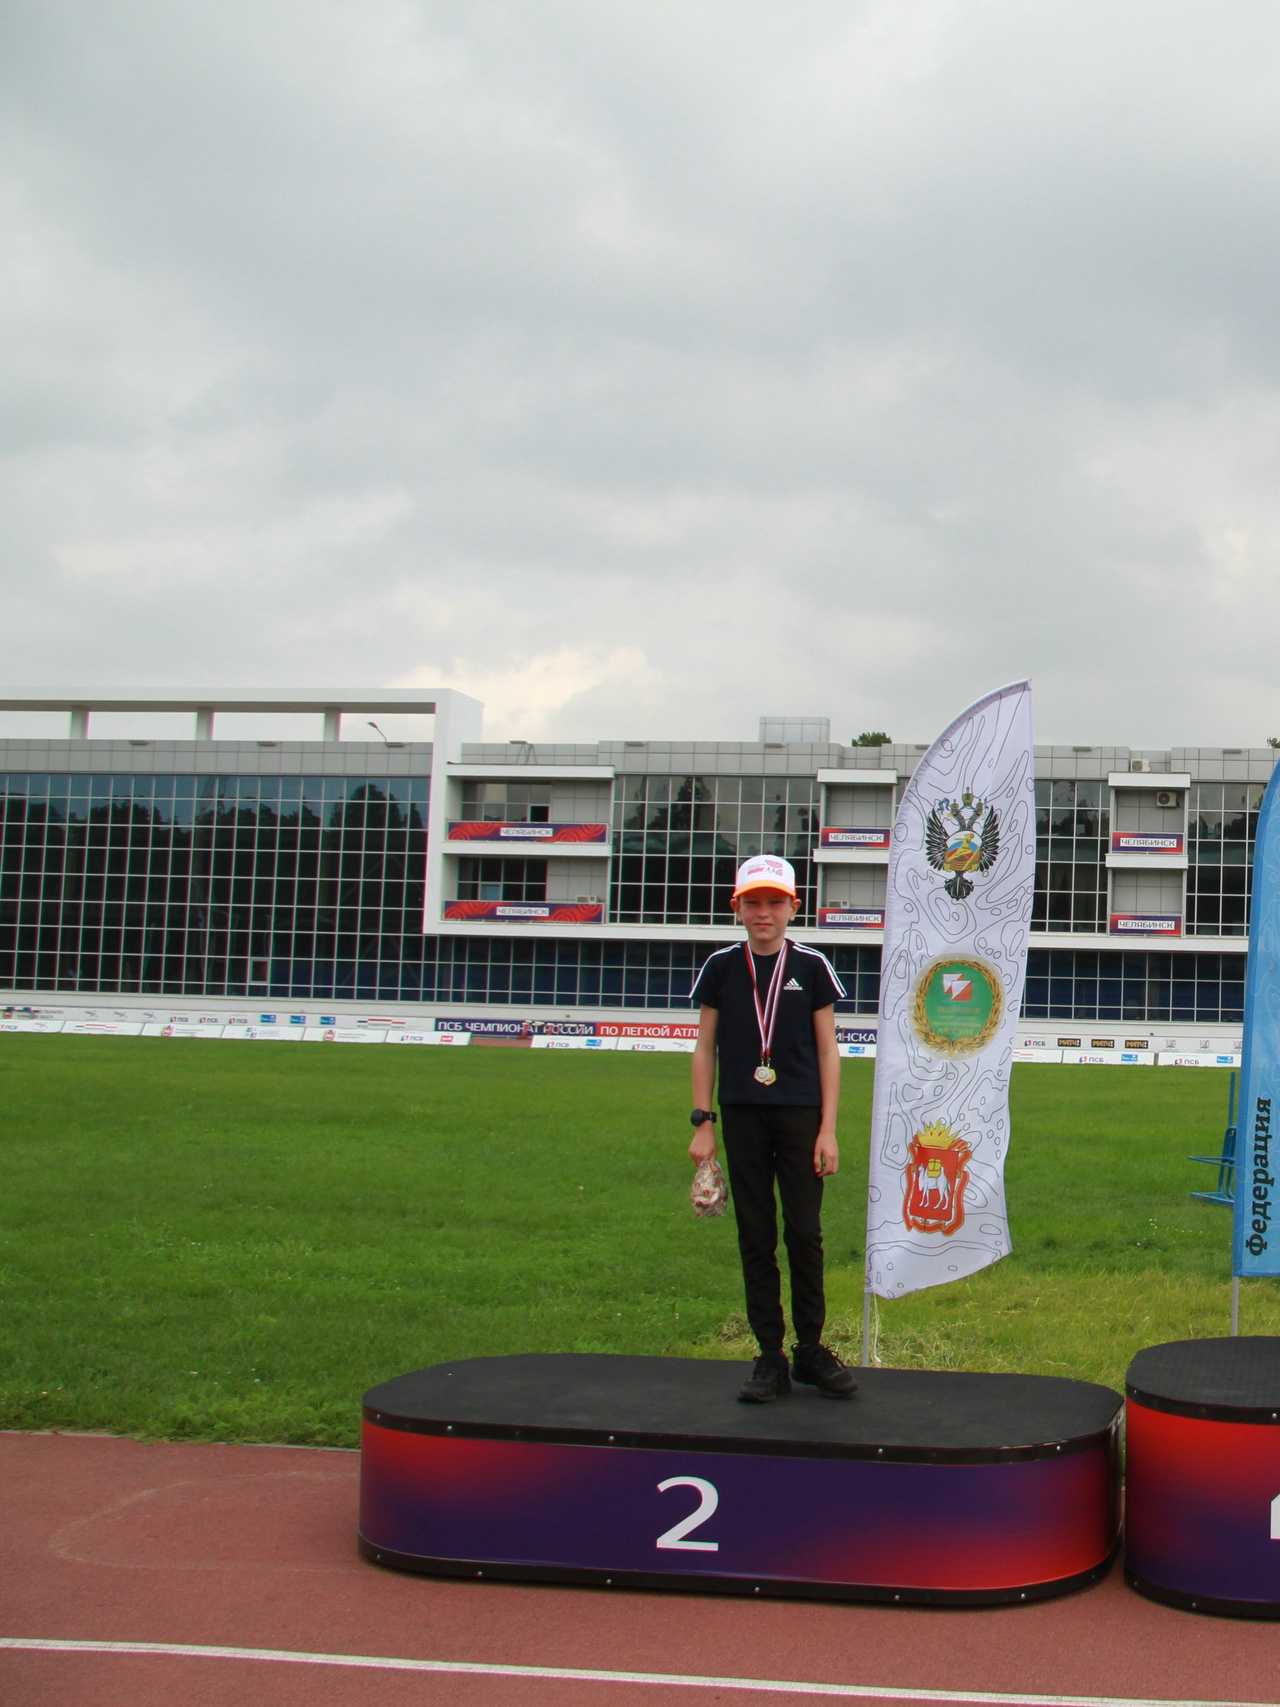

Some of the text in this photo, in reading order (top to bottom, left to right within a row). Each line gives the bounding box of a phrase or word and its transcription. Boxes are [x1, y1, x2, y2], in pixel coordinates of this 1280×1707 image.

[501, 828, 552, 836] ЧЕЛЯБИНСК
[829, 834, 883, 842] ЧЕЛЯБИНСК
[1121, 838, 1176, 847] ЧЕЛЯБИНСК
[497, 907, 549, 915] ЧЕЛЯБИНСК
[827, 914, 881, 922] ЧЕЛЯБИНСК
[1119, 921, 1174, 929] ЧЕЛЯБИНСК
[438, 1021, 463, 1031] ПСБ
[600, 1025, 619, 1036] ПО
[621, 1024, 670, 1037] ЛЕГКОЙ
[835, 1032, 877, 1042] ИНСКА
[1245, 1096, 1275, 1257] Федерация
[655, 1475, 720, 1552] 2
